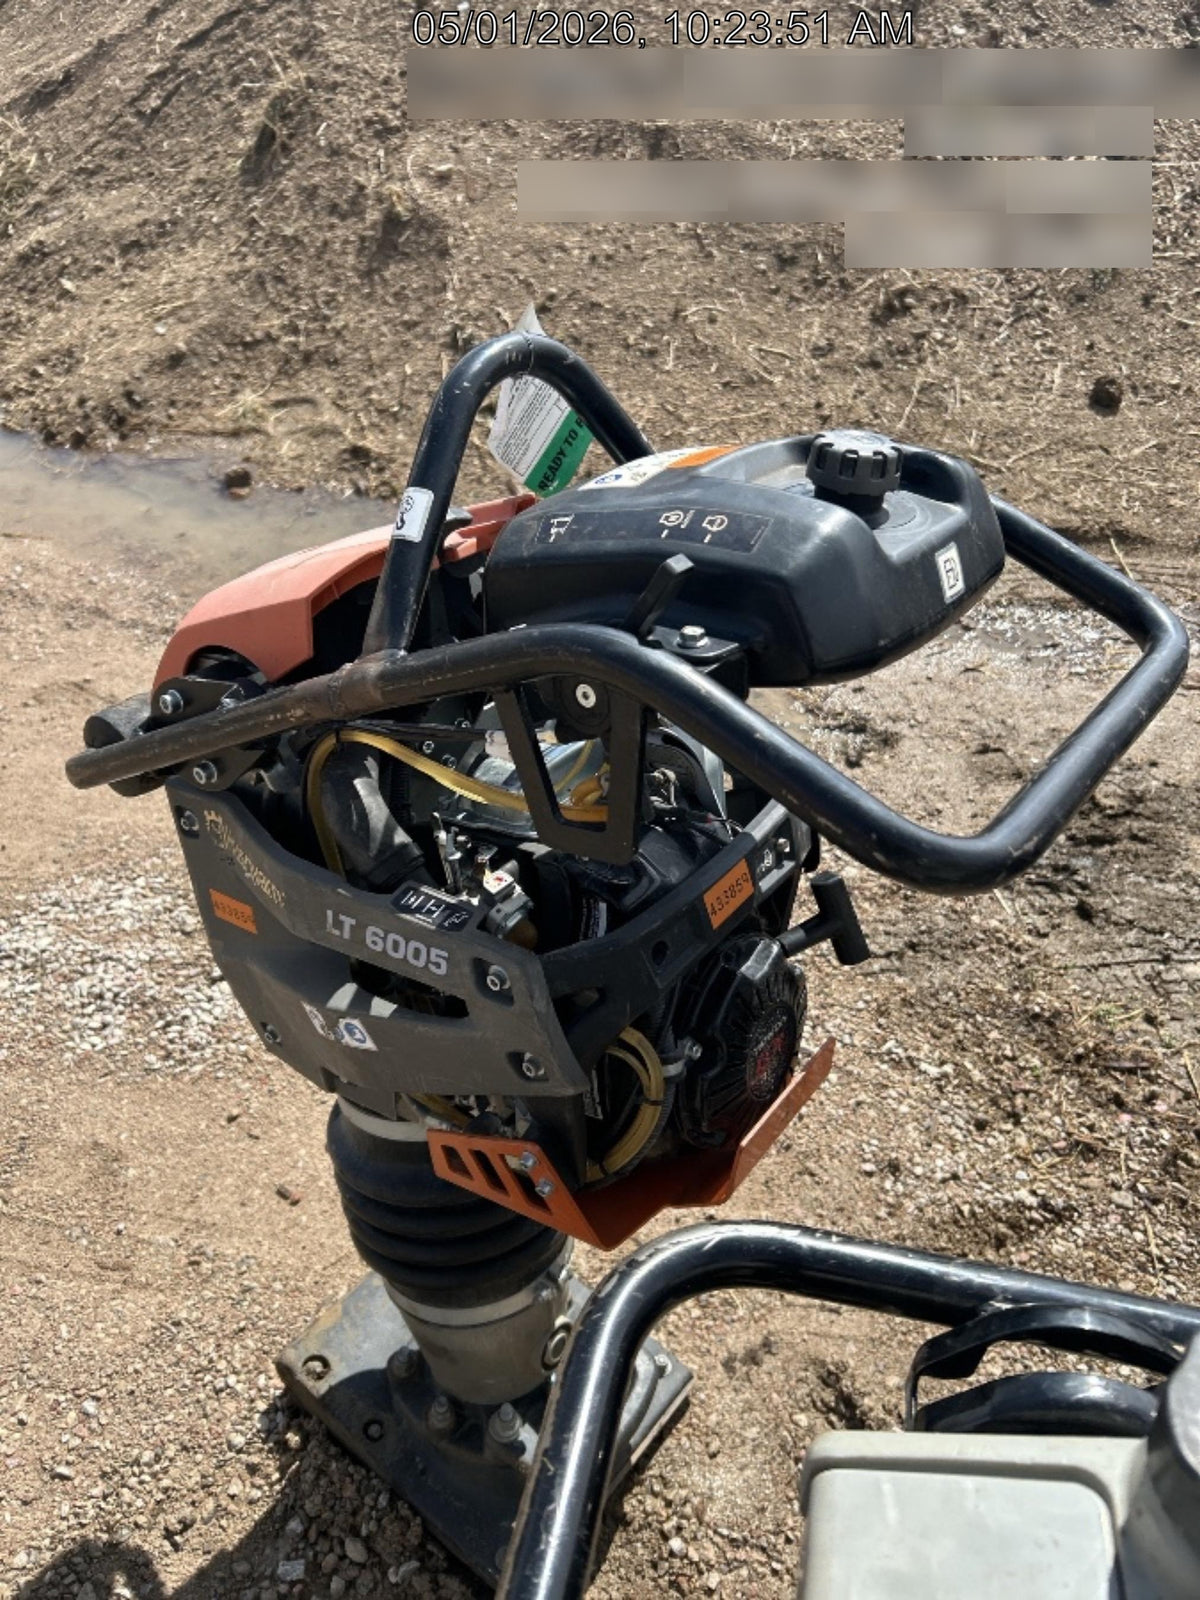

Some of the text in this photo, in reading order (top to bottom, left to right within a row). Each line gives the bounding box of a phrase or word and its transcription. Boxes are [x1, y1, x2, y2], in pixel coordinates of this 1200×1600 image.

[537, 429, 579, 491] READY TO
[326, 909, 449, 975] LT 6005
